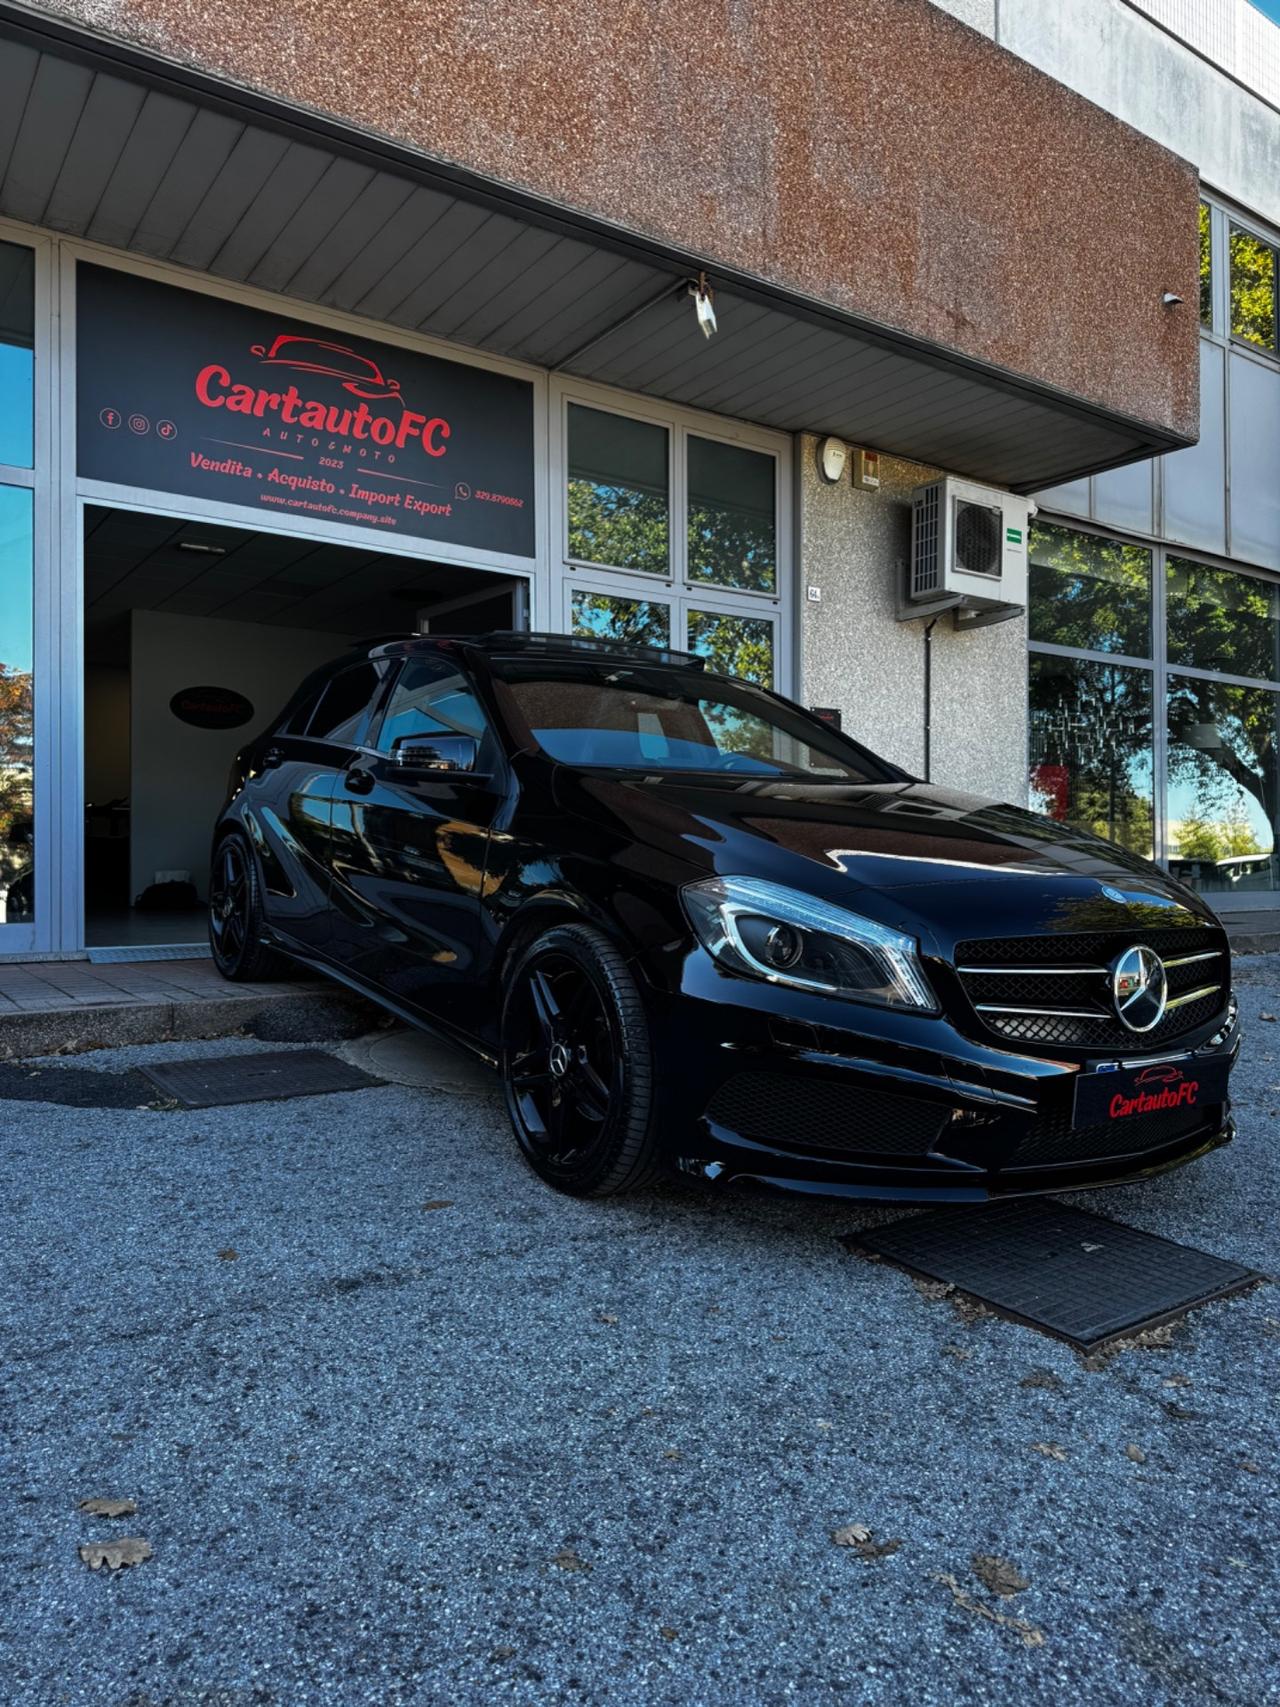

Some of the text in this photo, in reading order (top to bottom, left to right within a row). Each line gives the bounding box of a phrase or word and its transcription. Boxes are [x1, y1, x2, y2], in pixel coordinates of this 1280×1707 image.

[195, 364, 450, 457] CartautoFC
[190, 451, 453, 516] Vendita Acquisto Import Export
[261, 494, 397, 525] www.cartautofc.company.site
[1110, 1081, 1198, 1118] CartautoFC
